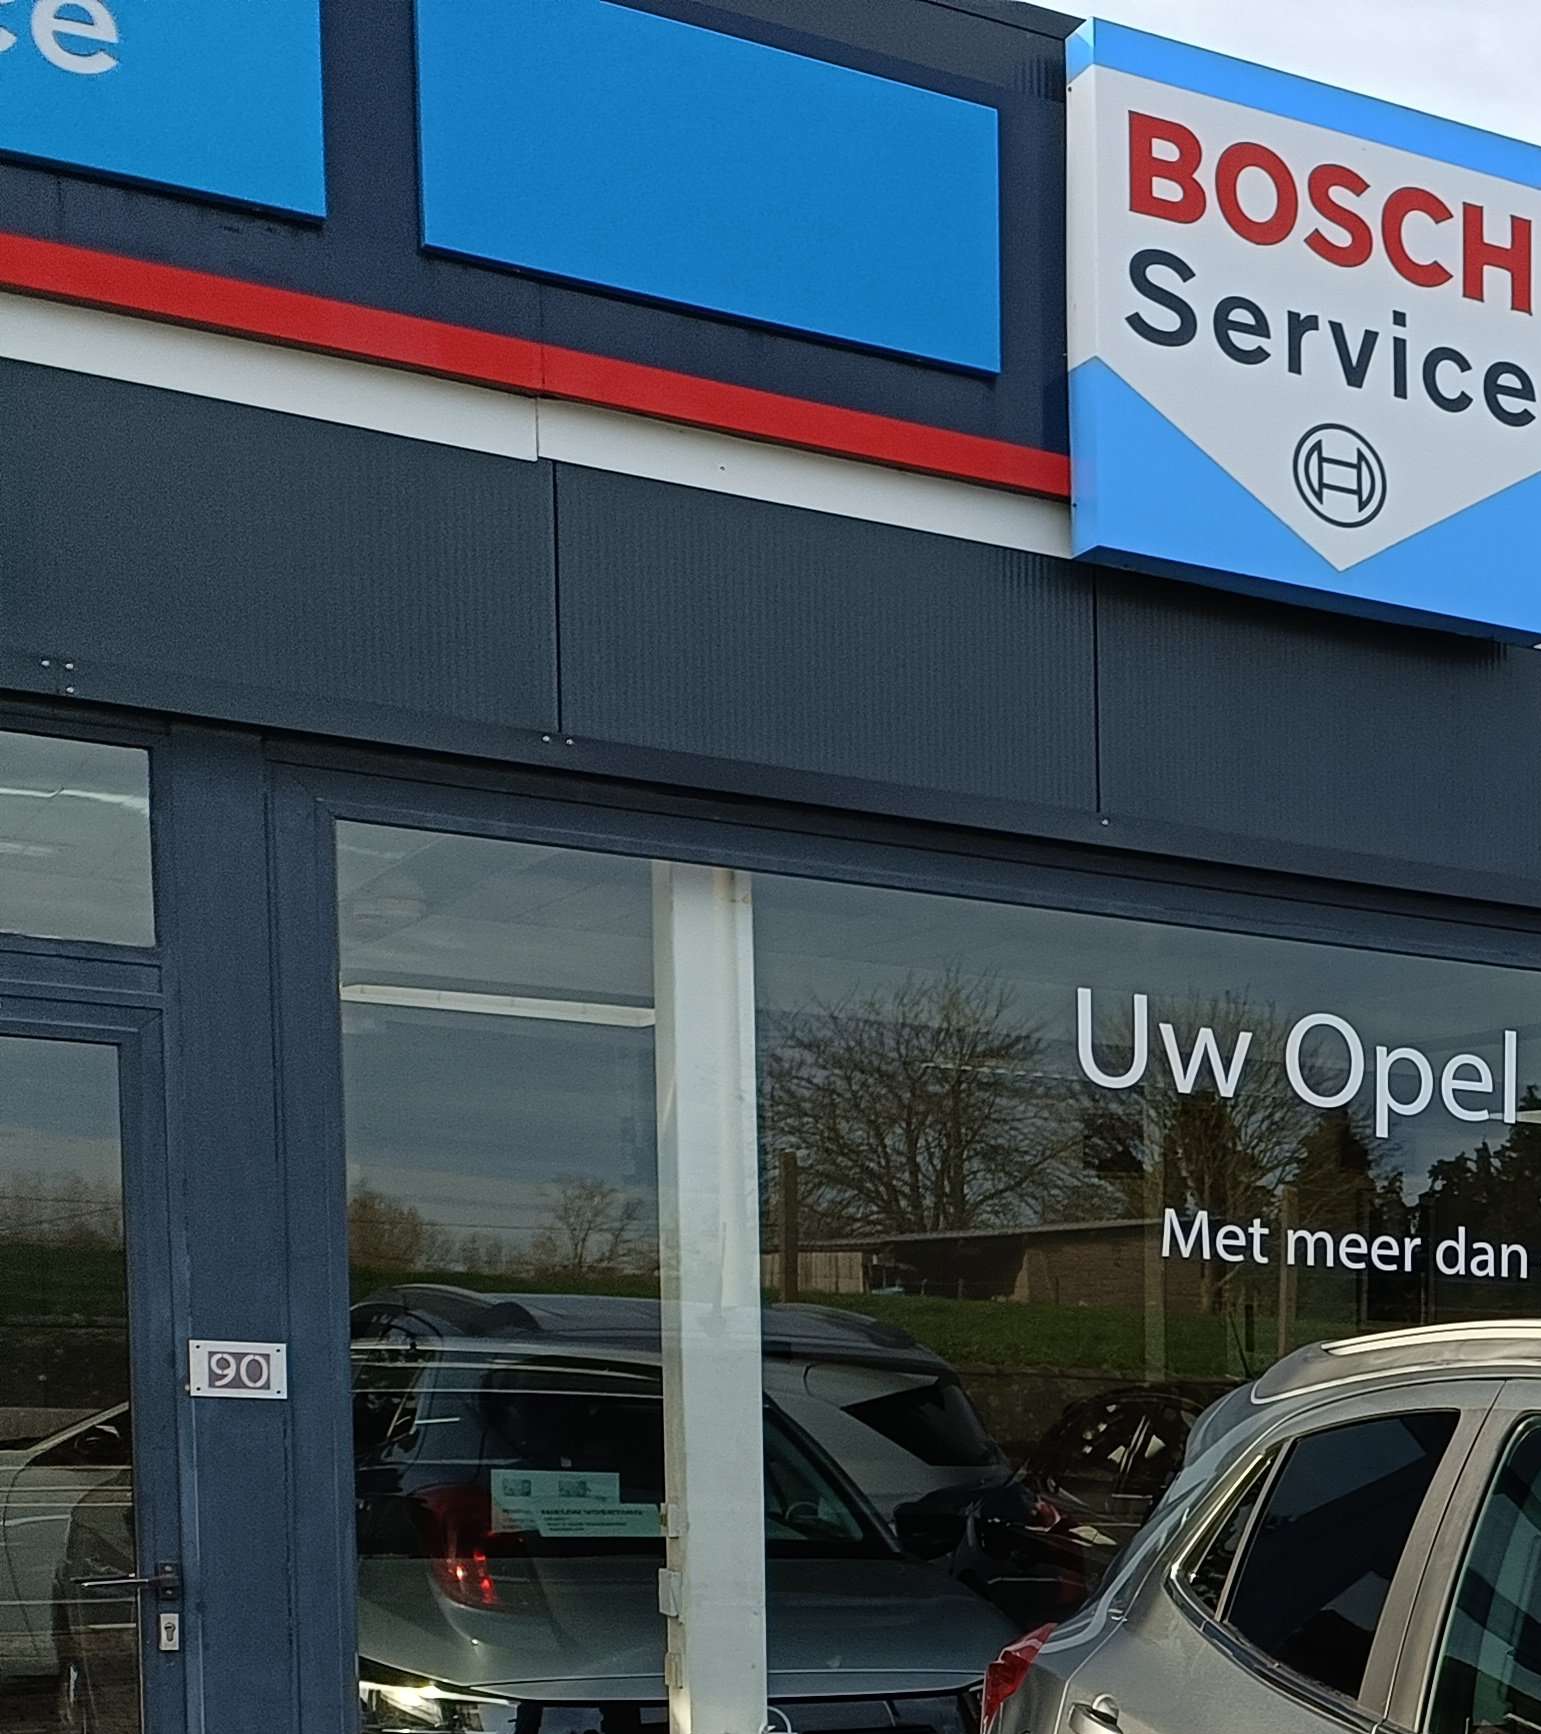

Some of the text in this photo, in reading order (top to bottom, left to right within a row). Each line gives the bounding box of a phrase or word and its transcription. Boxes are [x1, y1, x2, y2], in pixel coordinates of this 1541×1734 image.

[0, 0, 119, 75] e
[1127, 109, 1533, 317] BOSCH
[1124, 248, 1538, 428] Service
[1076, 986, 1254, 1098] Uw
[1284, 1012, 1518, 1139] Opel
[1161, 1207, 1270, 1265] Met
[1285, 1228, 1423, 1273] meer
[1435, 1225, 1529, 1280] dan
[210, 1352, 269, 1388] 90
